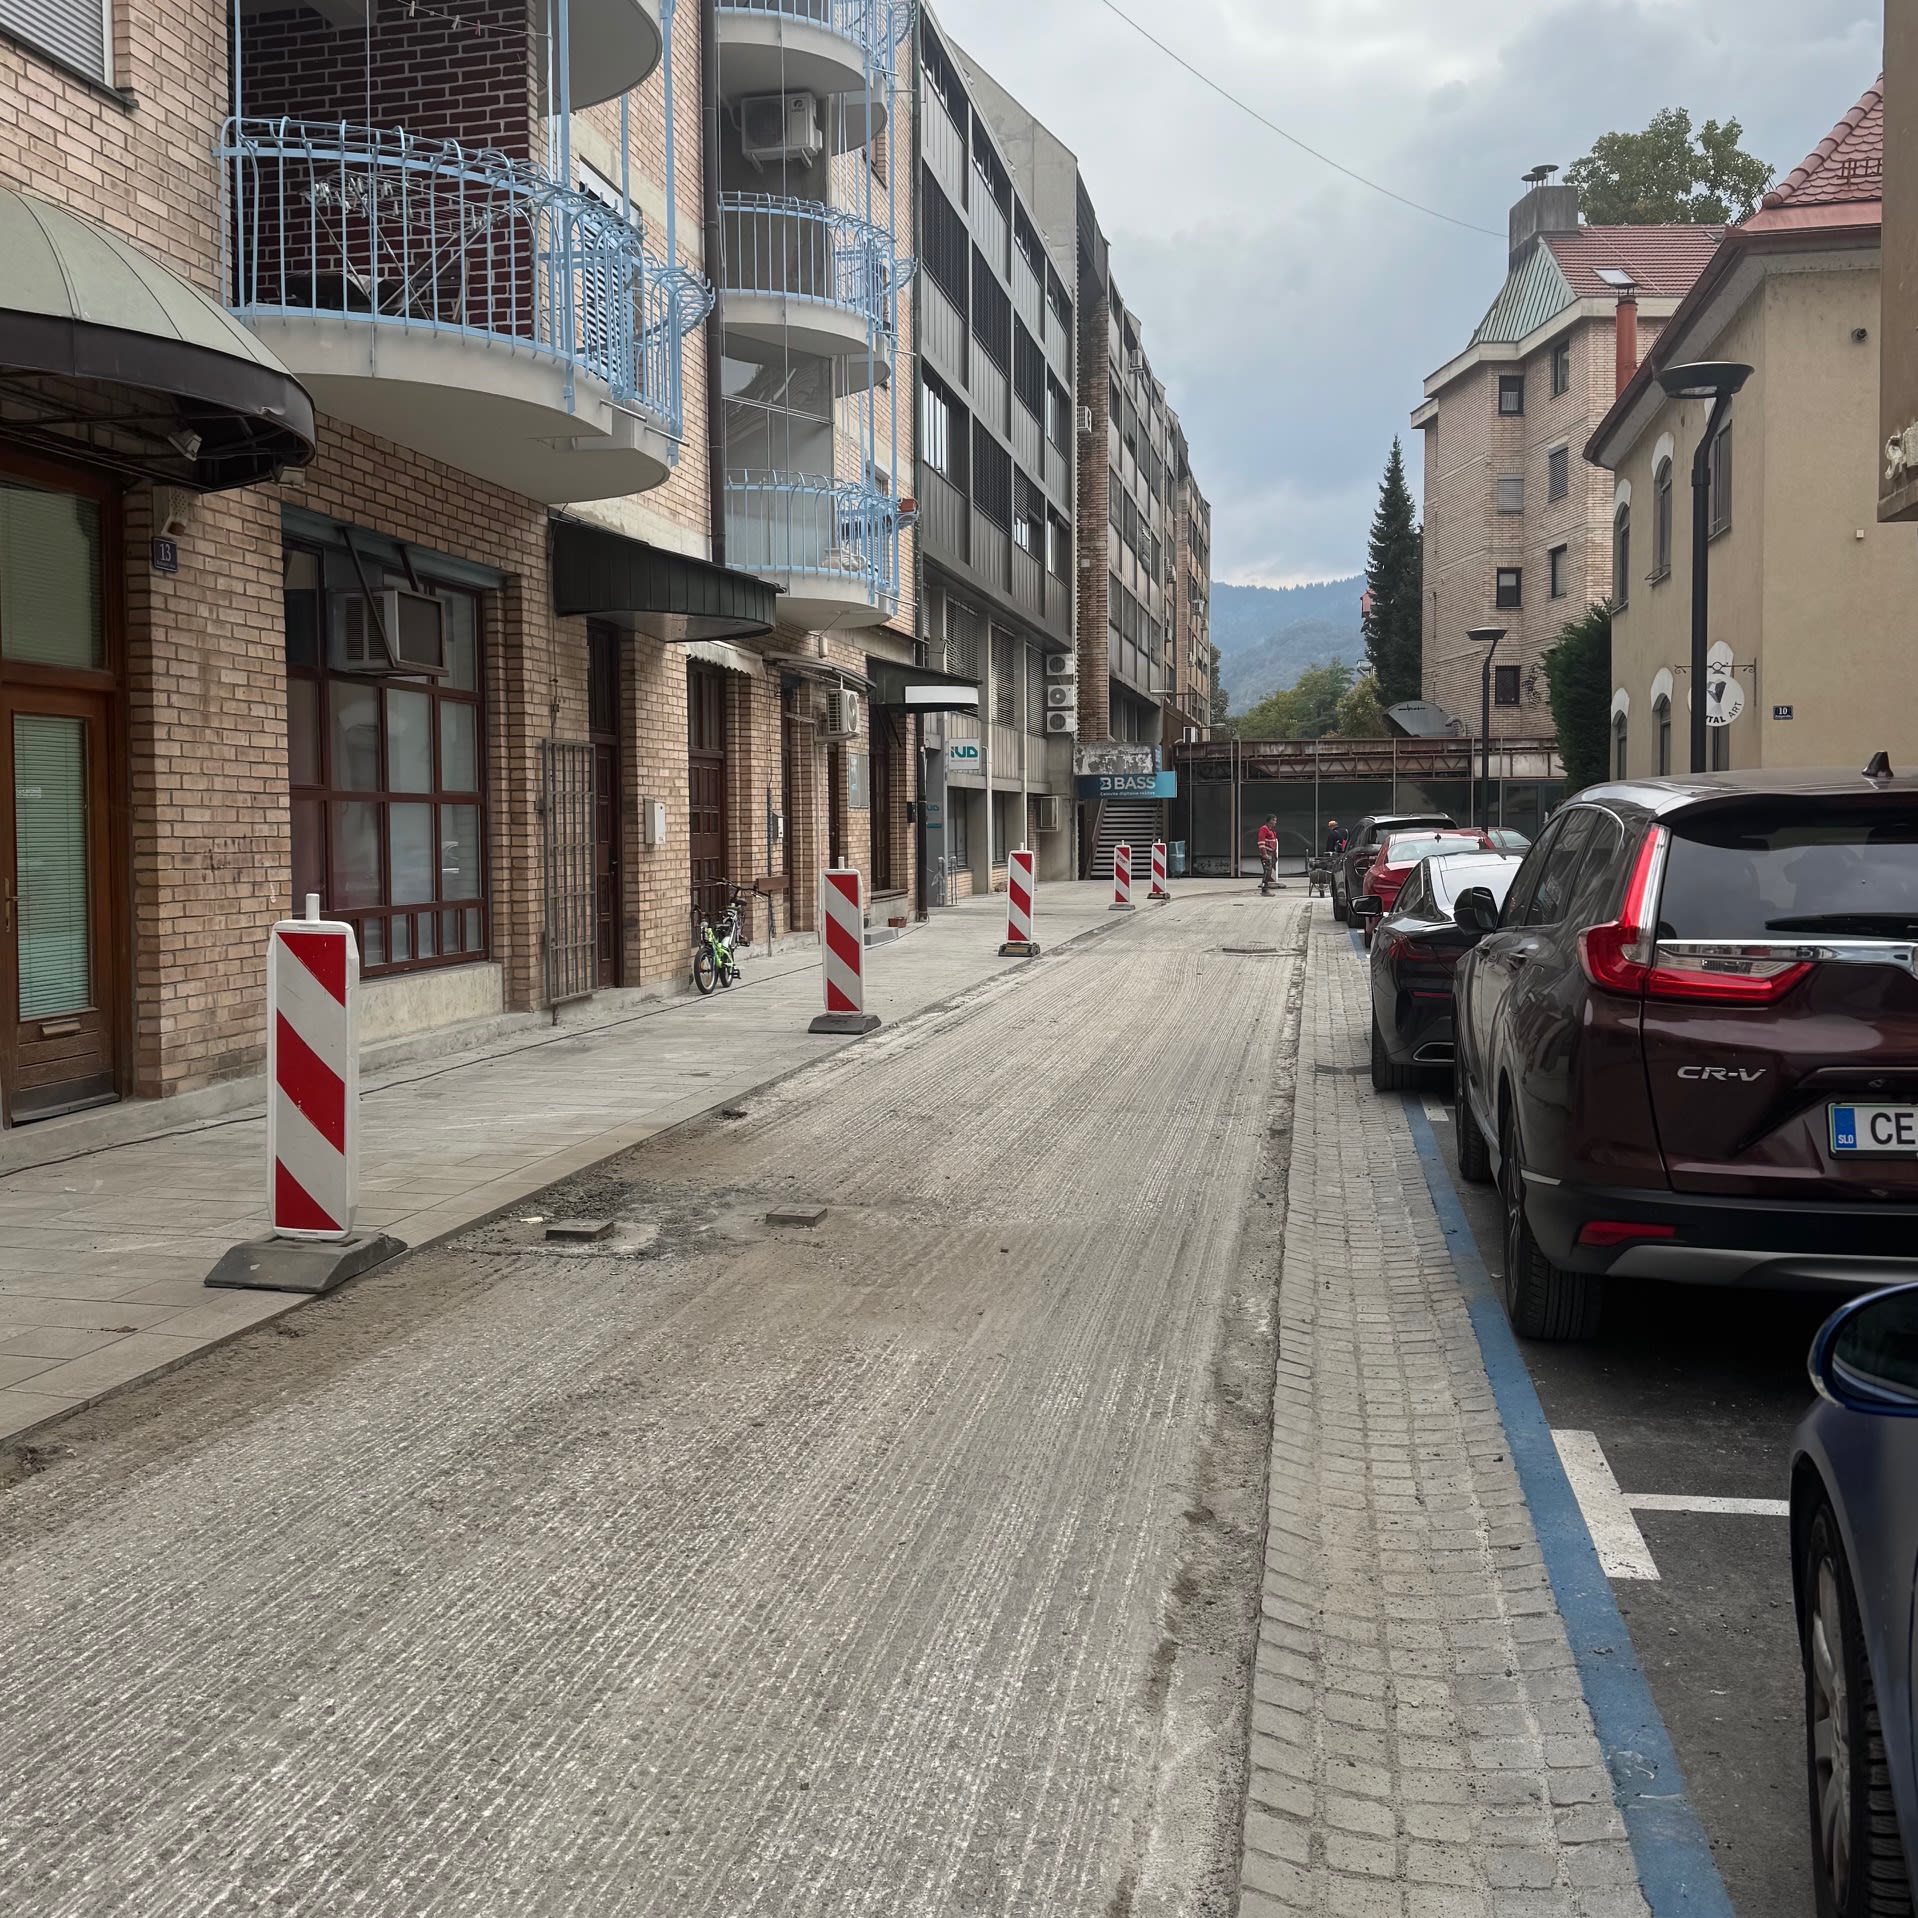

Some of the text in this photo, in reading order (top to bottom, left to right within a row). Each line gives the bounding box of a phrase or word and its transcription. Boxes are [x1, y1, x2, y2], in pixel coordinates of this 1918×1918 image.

[160, 543, 171, 562] 13
[1728, 701, 1742, 719] ART
[1779, 707, 1788, 715] 10
[1114, 776, 1156, 790] BASS
[1677, 1066, 1767, 1082] CR-V
[1870, 1112, 1916, 1145] CE
[1838, 1134, 1854, 1144] SLO
